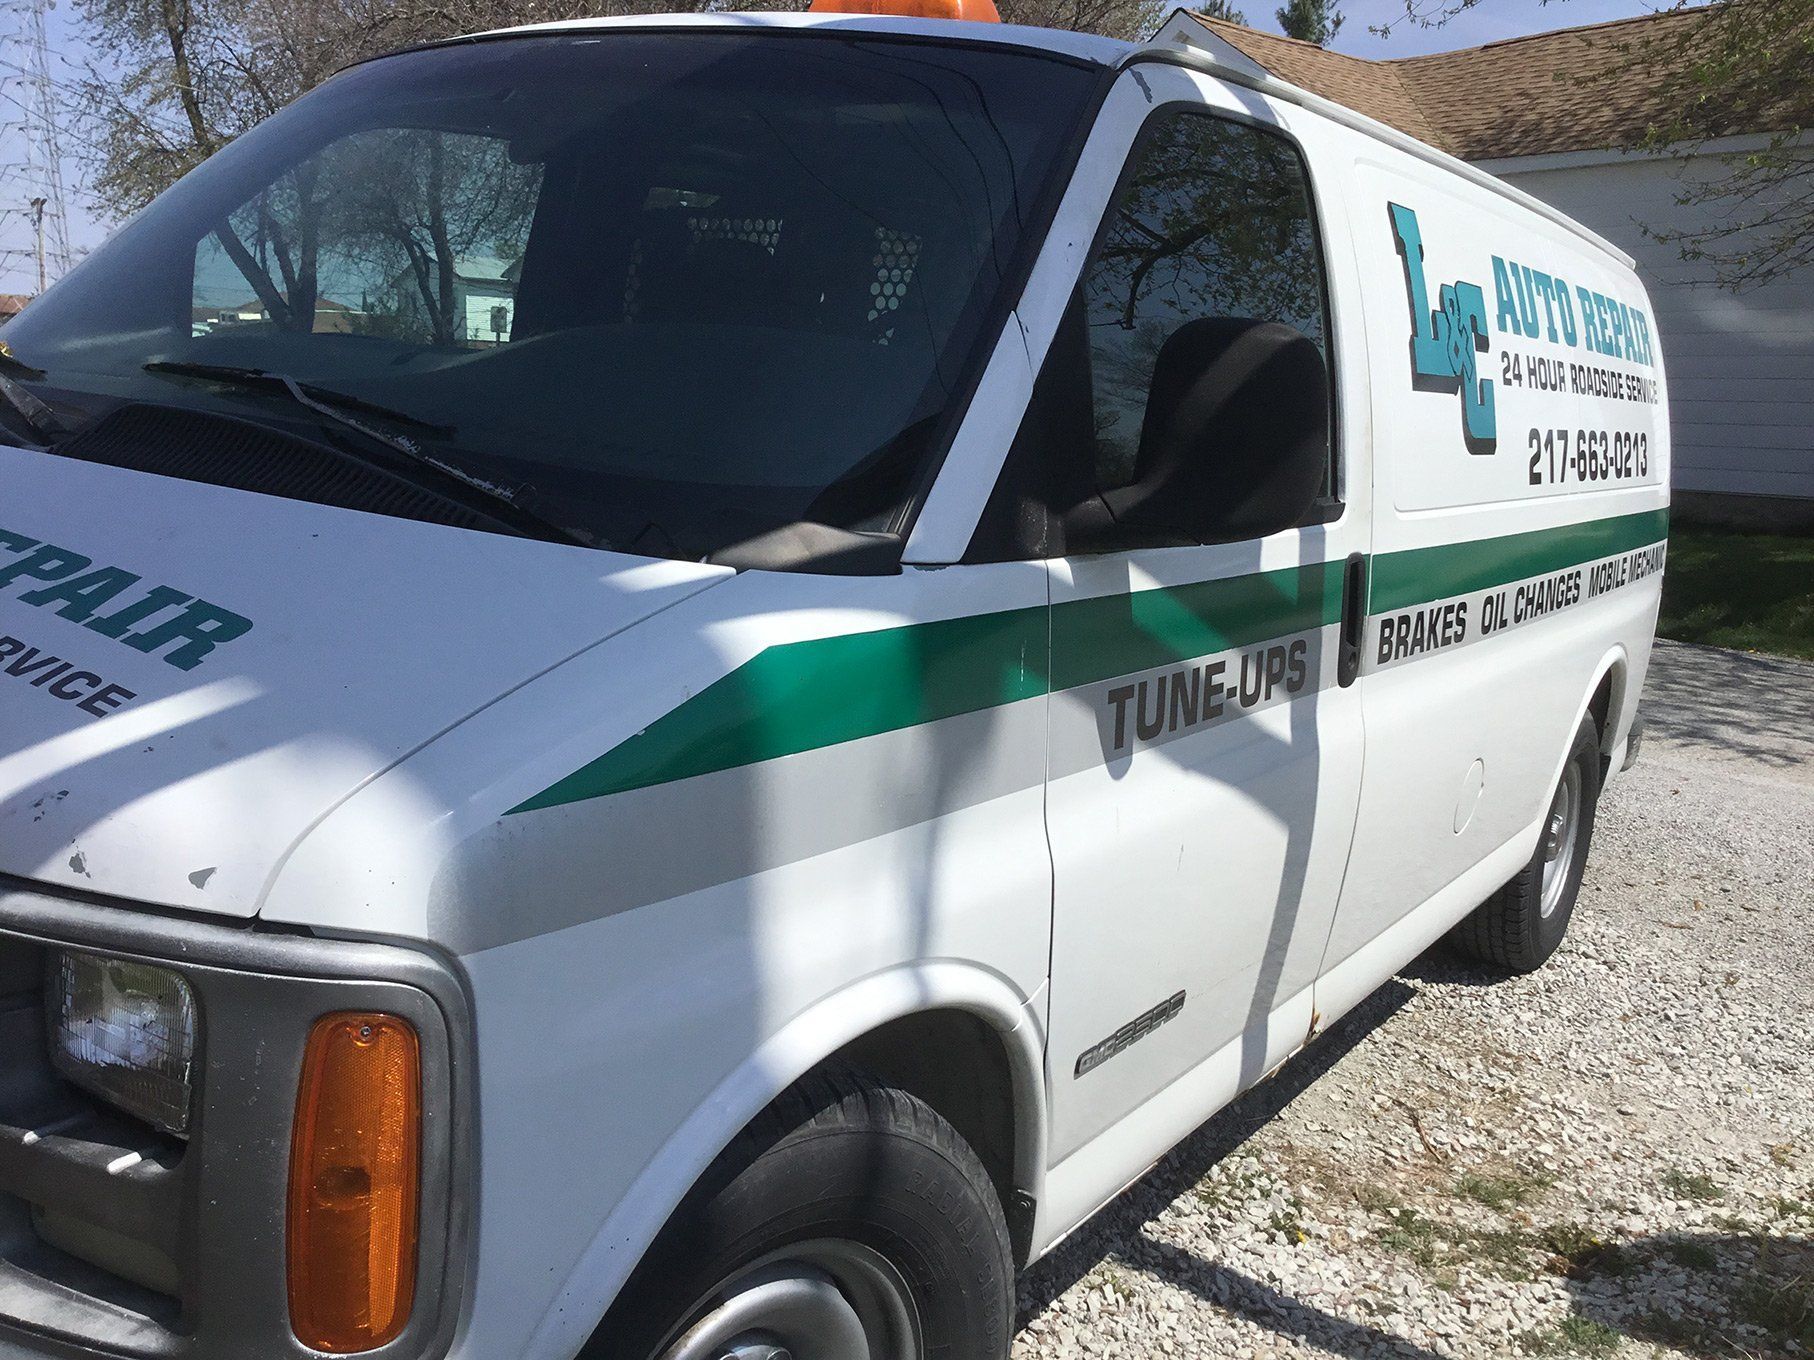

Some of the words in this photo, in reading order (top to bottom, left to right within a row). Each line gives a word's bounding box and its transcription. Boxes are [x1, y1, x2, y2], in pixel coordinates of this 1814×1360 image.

[1491, 255, 1577, 347] AUTO
[1576, 285, 1654, 368] REPAIR
[1501, 350, 1523, 387] 24
[1526, 355, 1567, 392] HOUR
[1569, 363, 1625, 400] ROADSIDE
[1626, 374, 1659, 405] SERVICE
[1528, 427, 1648, 485] 217-663-0213
[1377, 601, 1467, 665] BRAKES
[1481, 592, 1508, 636] OIL
[1514, 570, 1582, 624] CHANGES
[1588, 557, 1628, 599] MOBILE
[1108, 639, 1307, 750] TUNE-UPS
